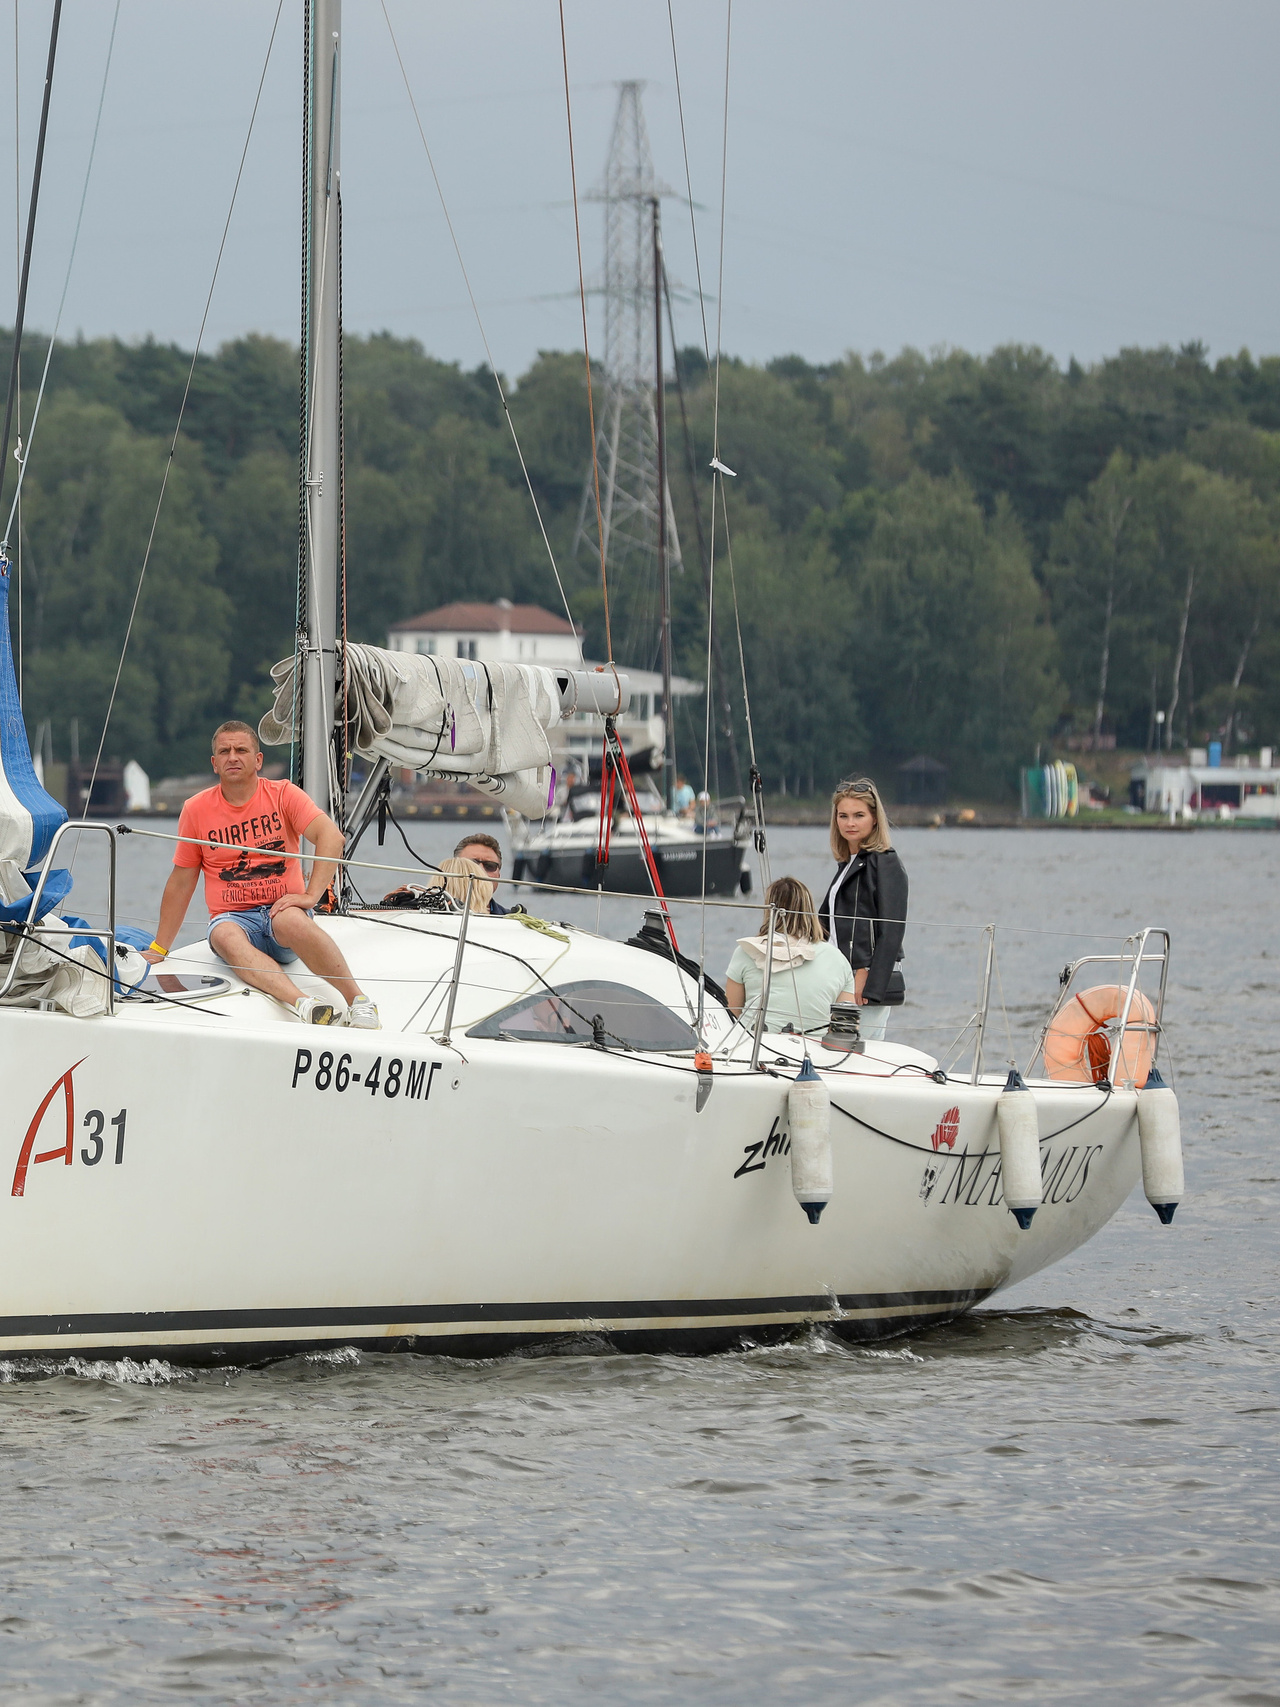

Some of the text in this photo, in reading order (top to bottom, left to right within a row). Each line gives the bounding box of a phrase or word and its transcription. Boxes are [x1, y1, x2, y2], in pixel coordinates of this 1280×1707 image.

[208, 811, 282, 851] SURFERS
[222, 888, 247, 902] VENICE
[251, 885, 277, 901] BEACH
[733, 1115, 792, 1179] zhi
